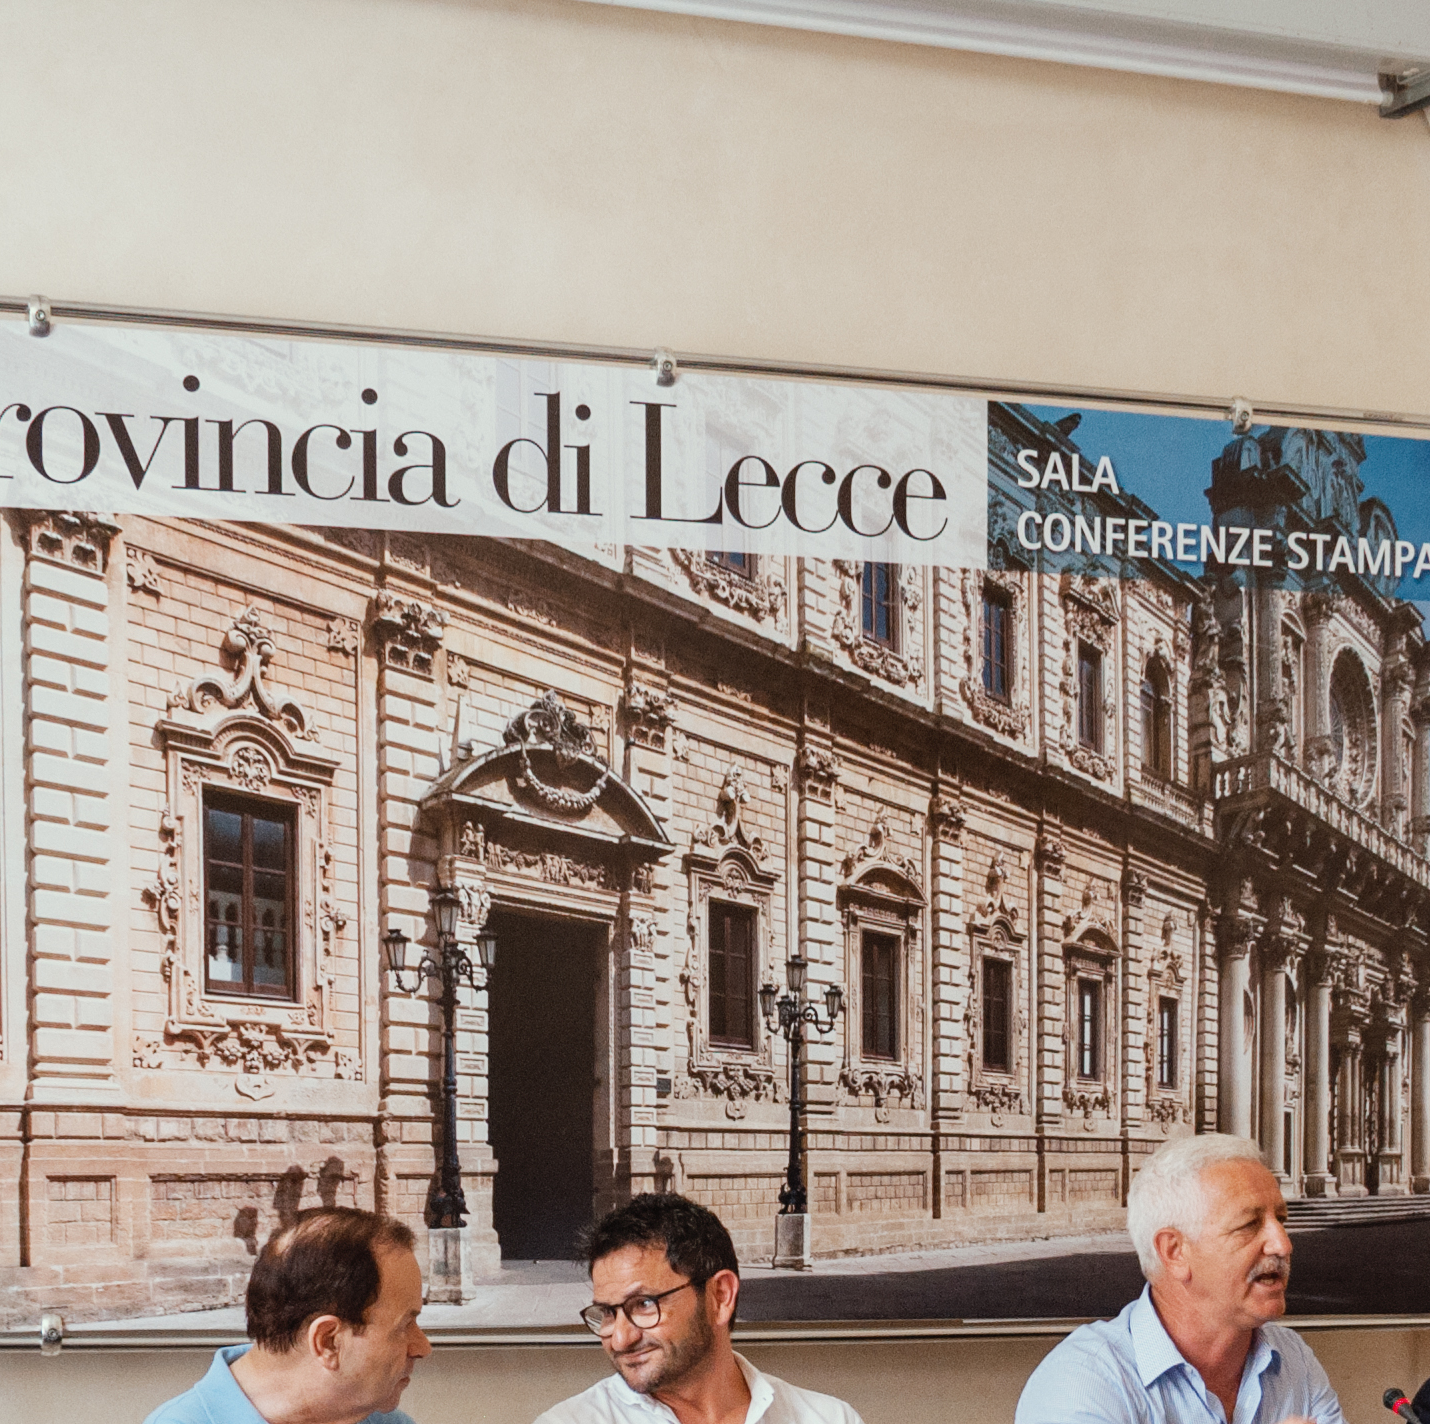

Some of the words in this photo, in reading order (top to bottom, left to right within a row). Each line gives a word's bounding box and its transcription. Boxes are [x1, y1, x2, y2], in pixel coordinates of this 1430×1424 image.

[492, 392, 602, 517] di
[630, 401, 948, 541] Lecce
[1016, 448, 1120, 495] SALA
[1017, 511, 1274, 567] CONFERENZE
